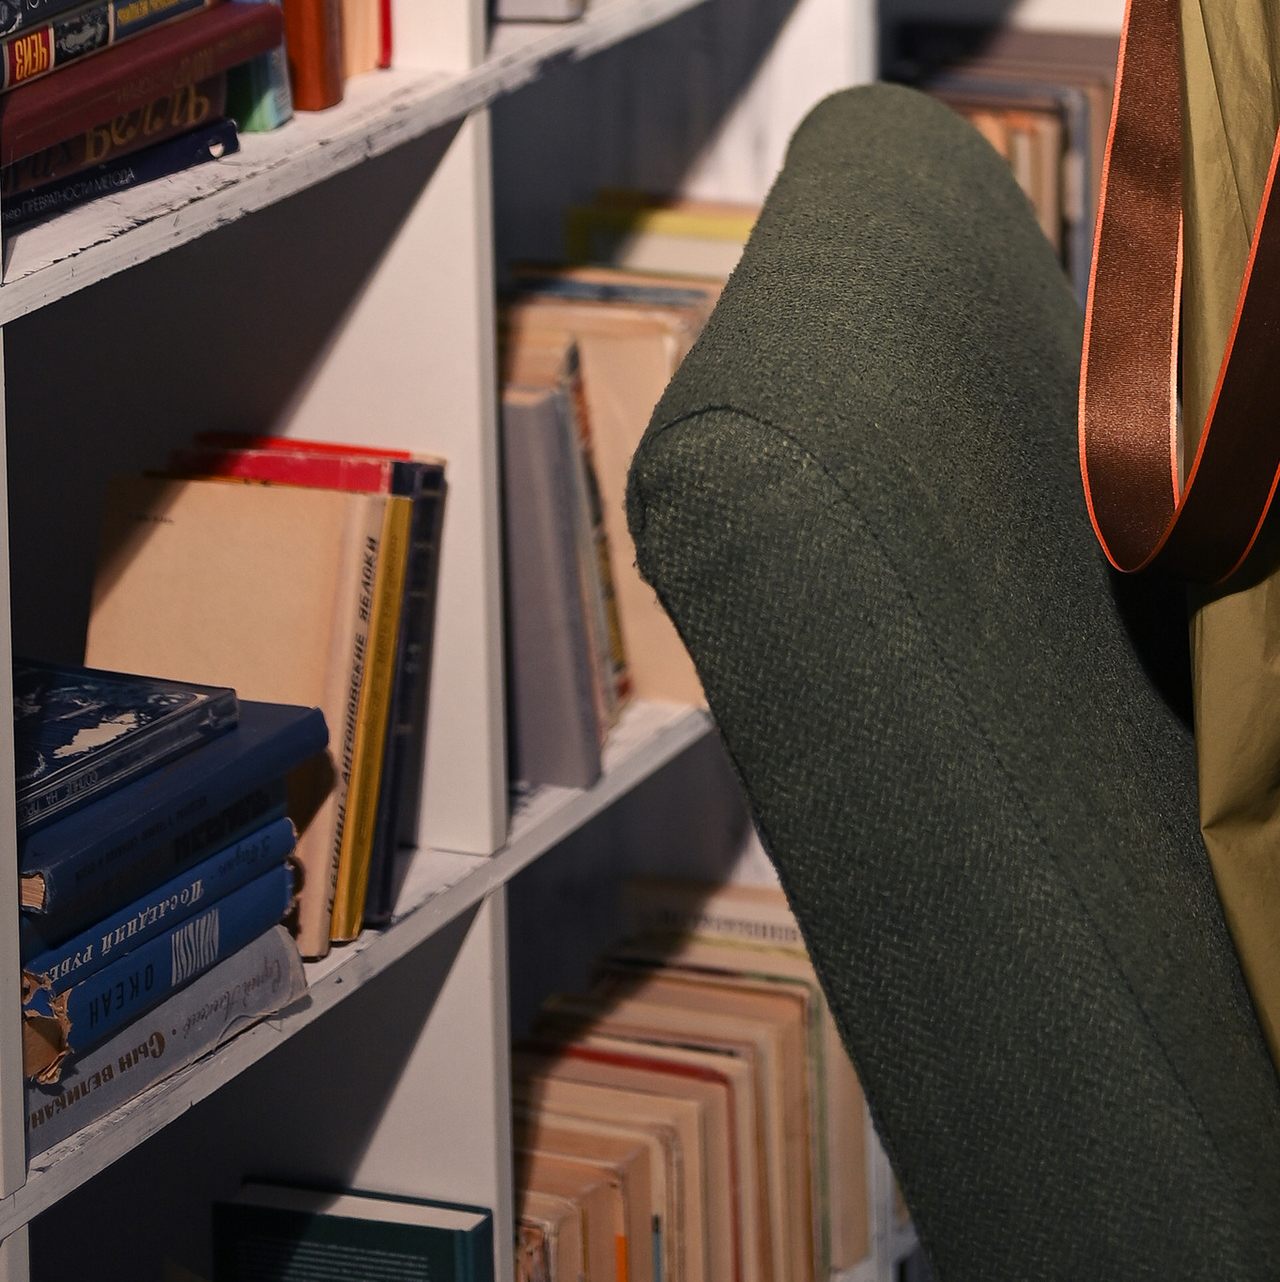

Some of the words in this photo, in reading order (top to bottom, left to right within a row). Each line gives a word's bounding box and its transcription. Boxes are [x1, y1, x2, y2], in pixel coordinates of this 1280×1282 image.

[22, 179, 93, 215] ПРЕВРАТНОСТИ
[92, 167, 136, 193] МЕТОДА
[342, 632, 366, 785] АНТОНОВСКИЕ
[357, 536, 378, 624] ЯБЛОКИ
[45, 790, 59, 806] НА
[42, 942, 94, 985] РУБЕ
[88, 963, 154, 1028] ОКЕАН
[27, 1067, 116, 1131] ВЕЛИКАН
